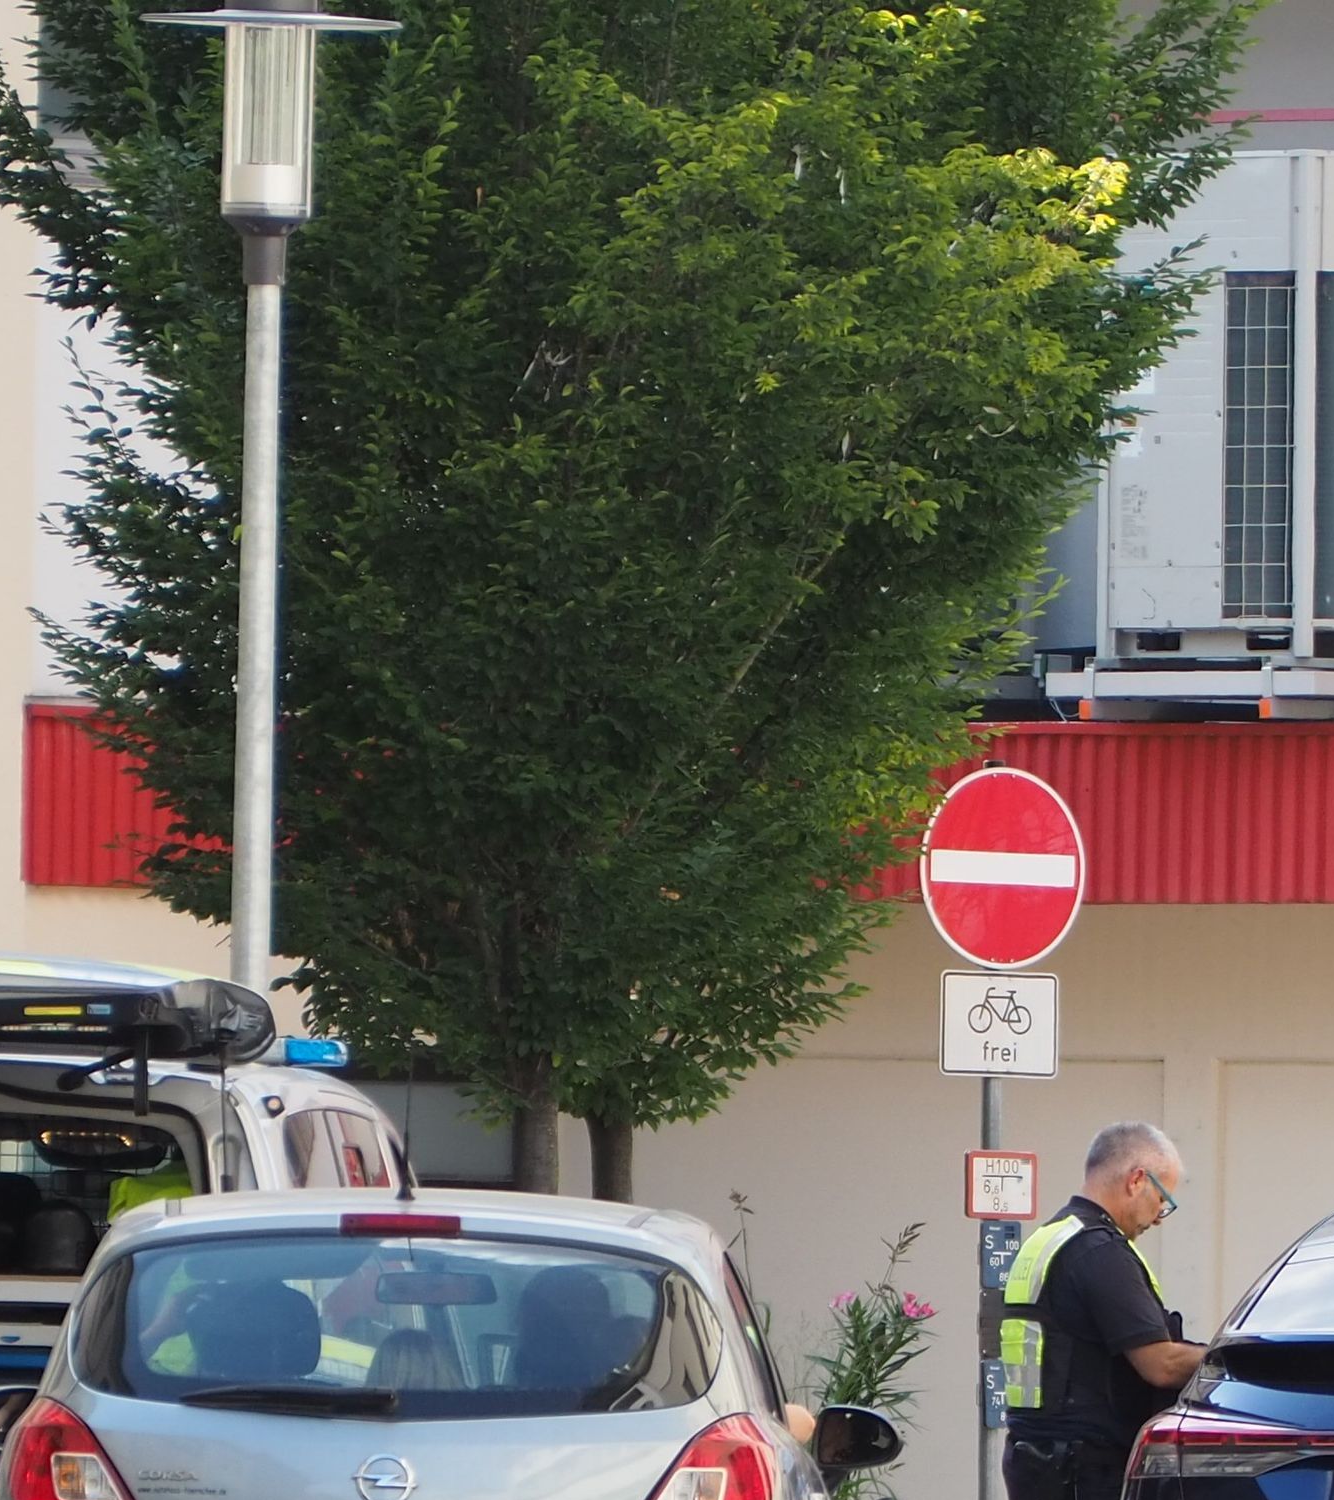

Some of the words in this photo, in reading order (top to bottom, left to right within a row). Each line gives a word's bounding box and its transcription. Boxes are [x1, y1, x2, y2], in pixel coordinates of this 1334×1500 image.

[982, 1041, 1017, 1062] frei
[985, 1159, 1019, 1174] H100
[984, 1234, 994, 1249] S
